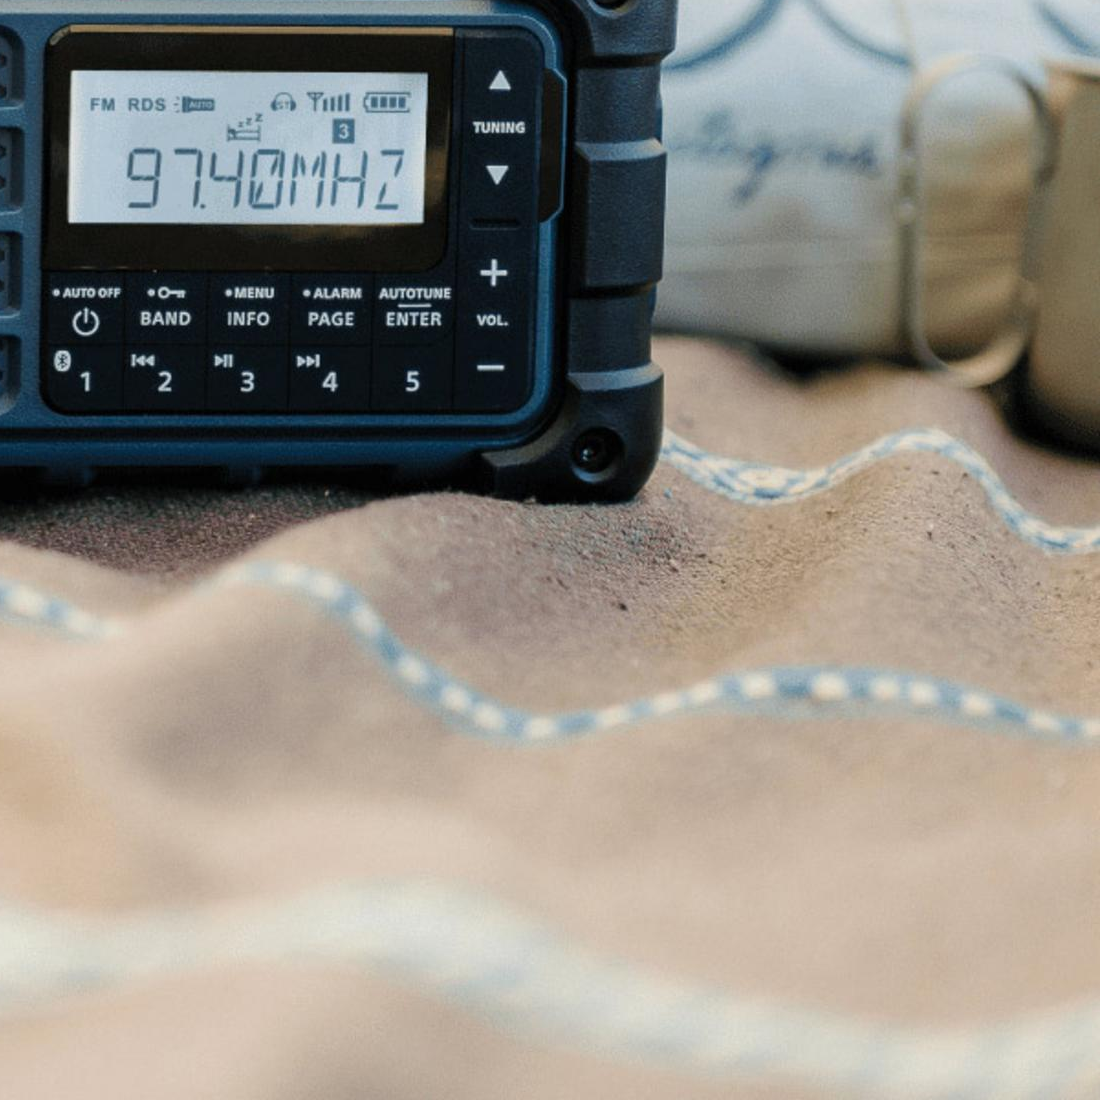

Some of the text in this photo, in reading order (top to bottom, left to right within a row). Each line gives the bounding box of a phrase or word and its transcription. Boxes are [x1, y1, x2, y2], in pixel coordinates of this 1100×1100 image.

[90, 98, 166, 111] FM RDS
[339, 124, 349, 139] 3
[473, 121, 525, 134] TUNING
[63, 287, 121, 298] AUTO OFF
[234, 287, 274, 299] MENU
[313, 287, 362, 299] ALARM
[379, 288, 451, 299] AUTOTUNE
[140, 311, 191, 326] BAND
[227, 311, 270, 326] INFO
[308, 311, 355, 326] PAGE
[386, 311, 442, 326] ENTER
[476, 314, 508, 326] VOL.
[80, 371, 91, 392] 1
[157, 371, 172, 392] 2
[240, 371, 255, 392] 3
[322, 371, 338, 392] 4
[405, 371, 420, 392] 5
